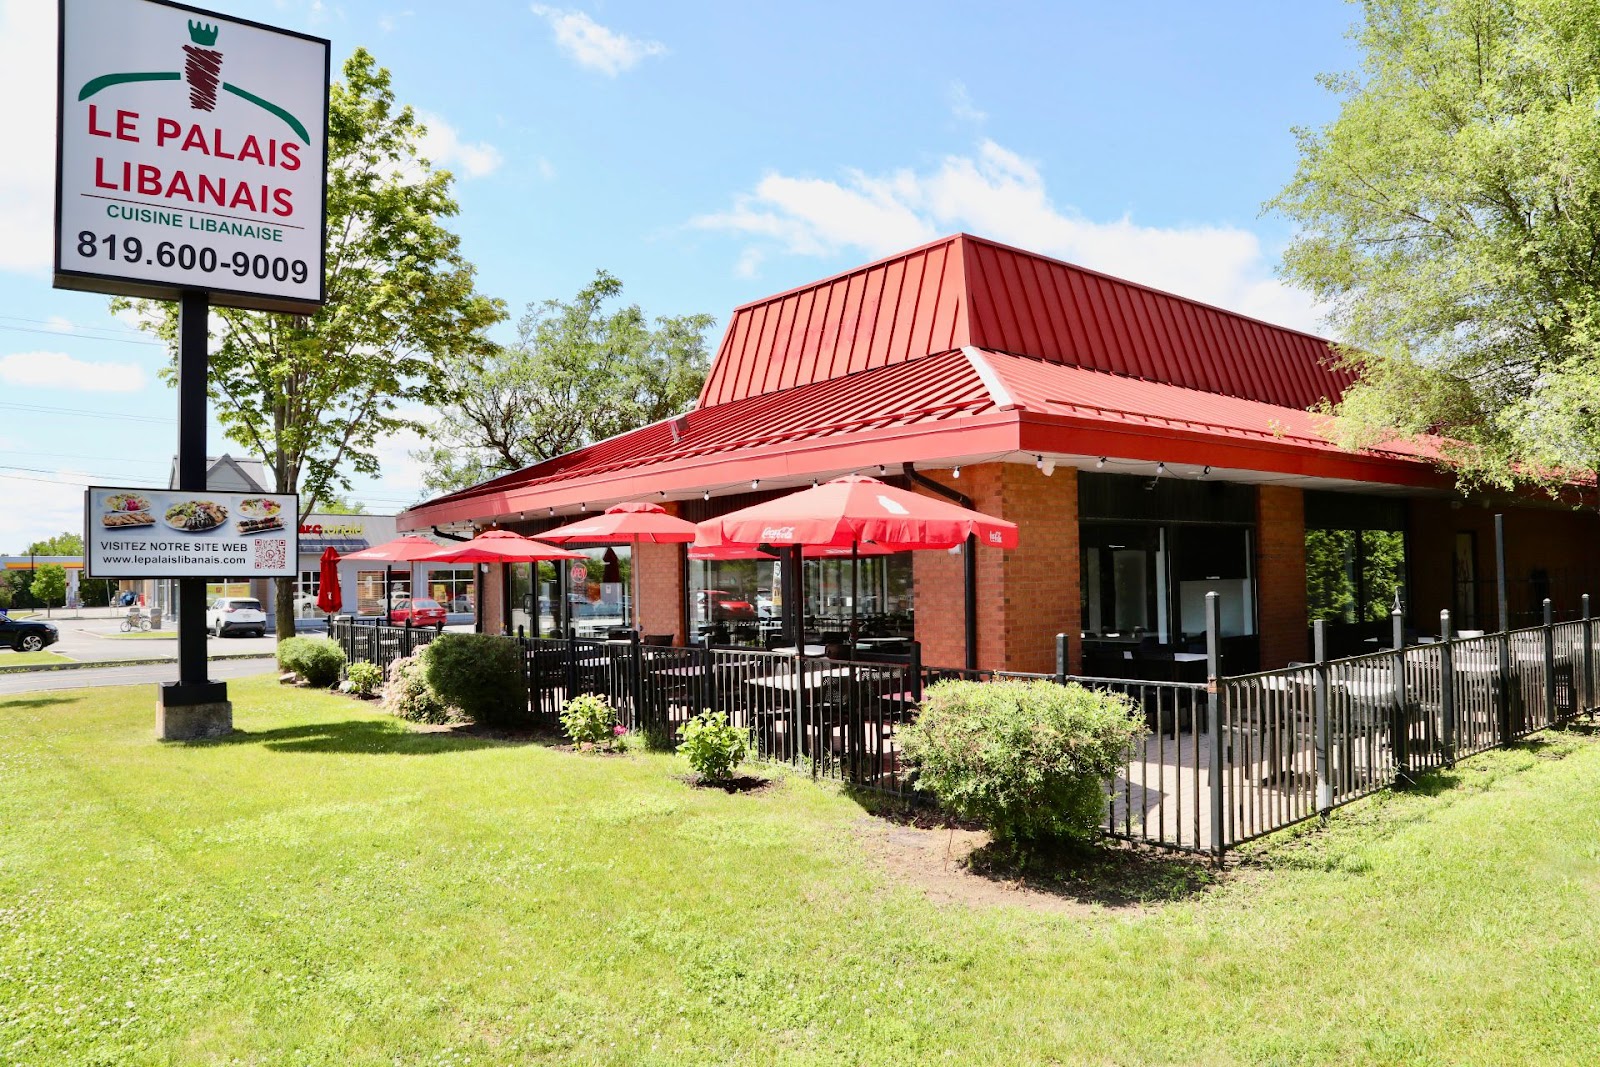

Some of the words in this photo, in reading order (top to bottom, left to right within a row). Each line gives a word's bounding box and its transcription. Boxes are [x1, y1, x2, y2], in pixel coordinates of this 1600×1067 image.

[88, 104, 140, 143] LE
[157, 117, 301, 171] PALAIS
[95, 157, 294, 217] LIBANAIS
[106, 204, 183, 228] CUISINE
[189, 216, 283, 242] LIBANAISE
[77, 230, 308, 284] 819.600-9009
[100, 541, 147, 551] VISITEZ
[150, 542, 191, 552] NOTRE
[194, 542, 219, 552] SITE
[222, 543, 248, 552] WEB
[102, 554, 246, 566] www.lepalaislibanais.com
